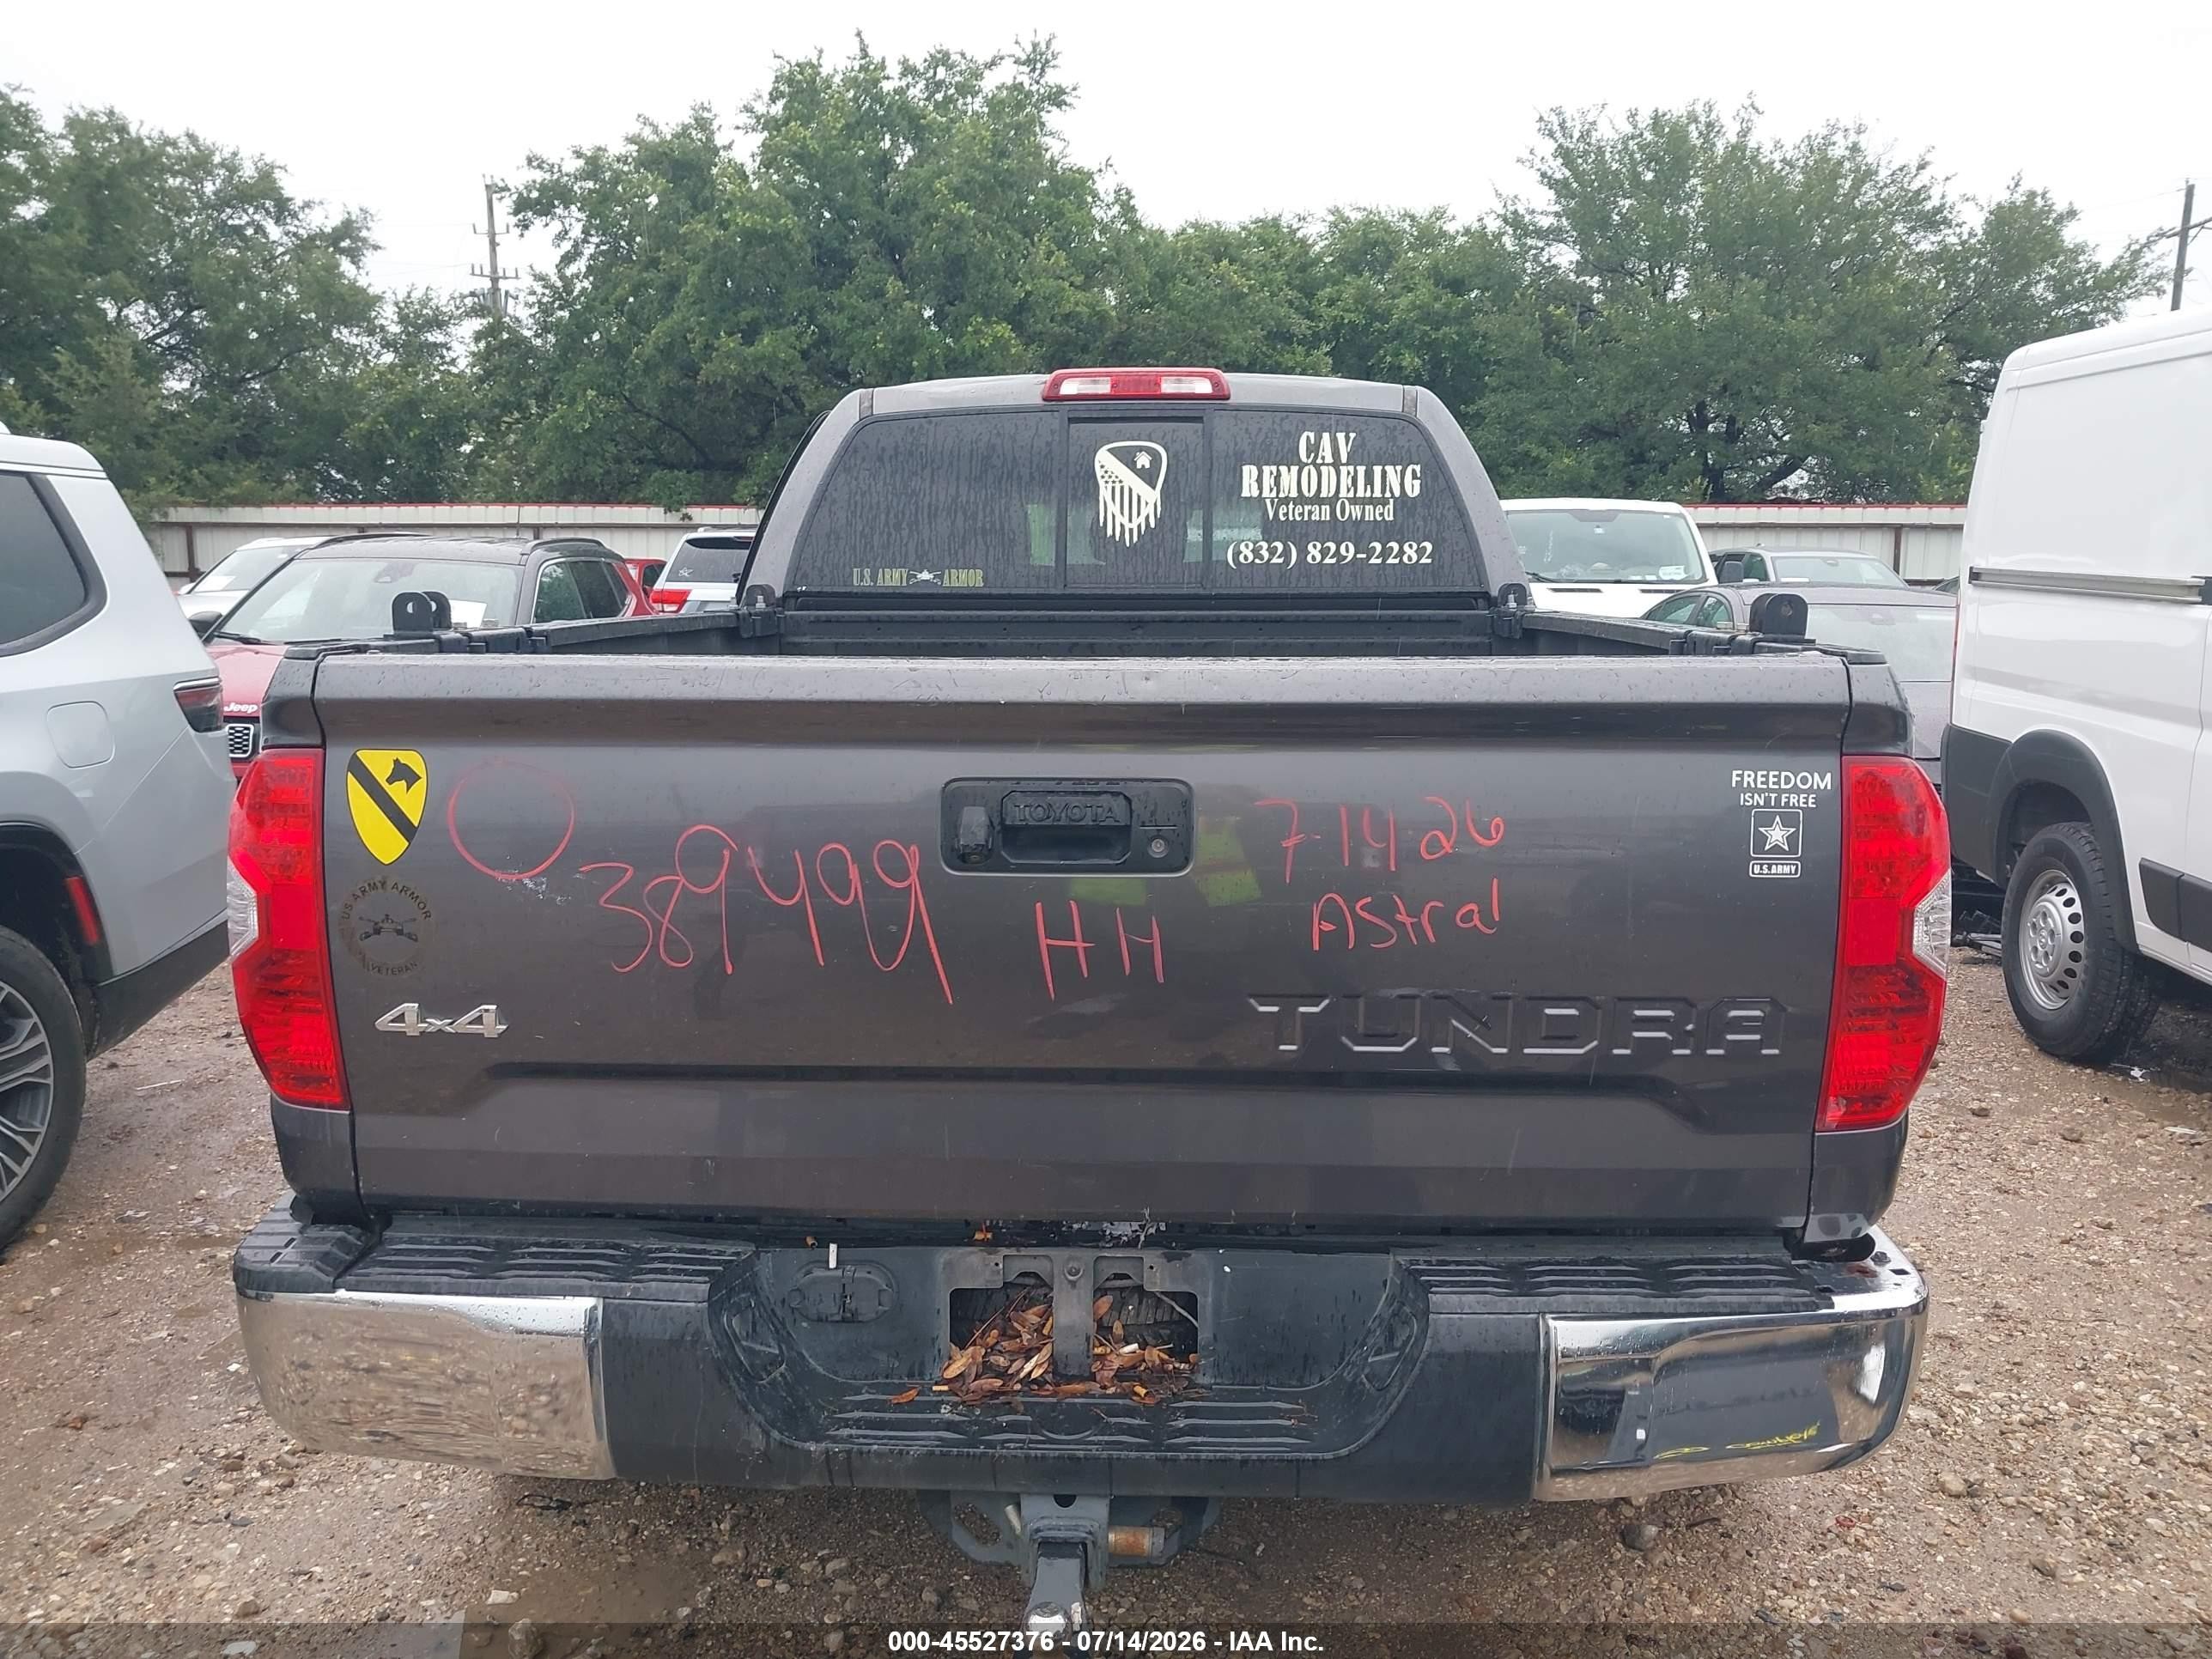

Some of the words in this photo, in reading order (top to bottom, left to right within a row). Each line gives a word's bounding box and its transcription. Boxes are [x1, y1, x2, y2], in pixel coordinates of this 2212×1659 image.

[1298, 431, 1357, 464] CAV
[1241, 464, 1422, 498] REMODELING
[1265, 498, 1330, 521] Veteran
[1335, 498, 1395, 521] Owned
[1226, 541, 1297, 569] (832)
[1306, 541, 1433, 564] 829-2282
[853, 568, 874, 586] U.S.
[877, 568, 908, 586] ARMY
[943, 569, 985, 587] ARMOR
[223, 702, 258, 714] Jeep
[1731, 769, 1832, 790] FREEDOM
[1740, 793, 1778, 806] ISN'T
[1781, 793, 1817, 807] FREE
[1014, 804, 1121, 823] TOYOTA
[342, 902, 354, 921] US
[351, 878, 388, 901] ARMY
[391, 880, 433, 921] ARMOR
[1248, 994, 1788, 1056] TUNDRA
